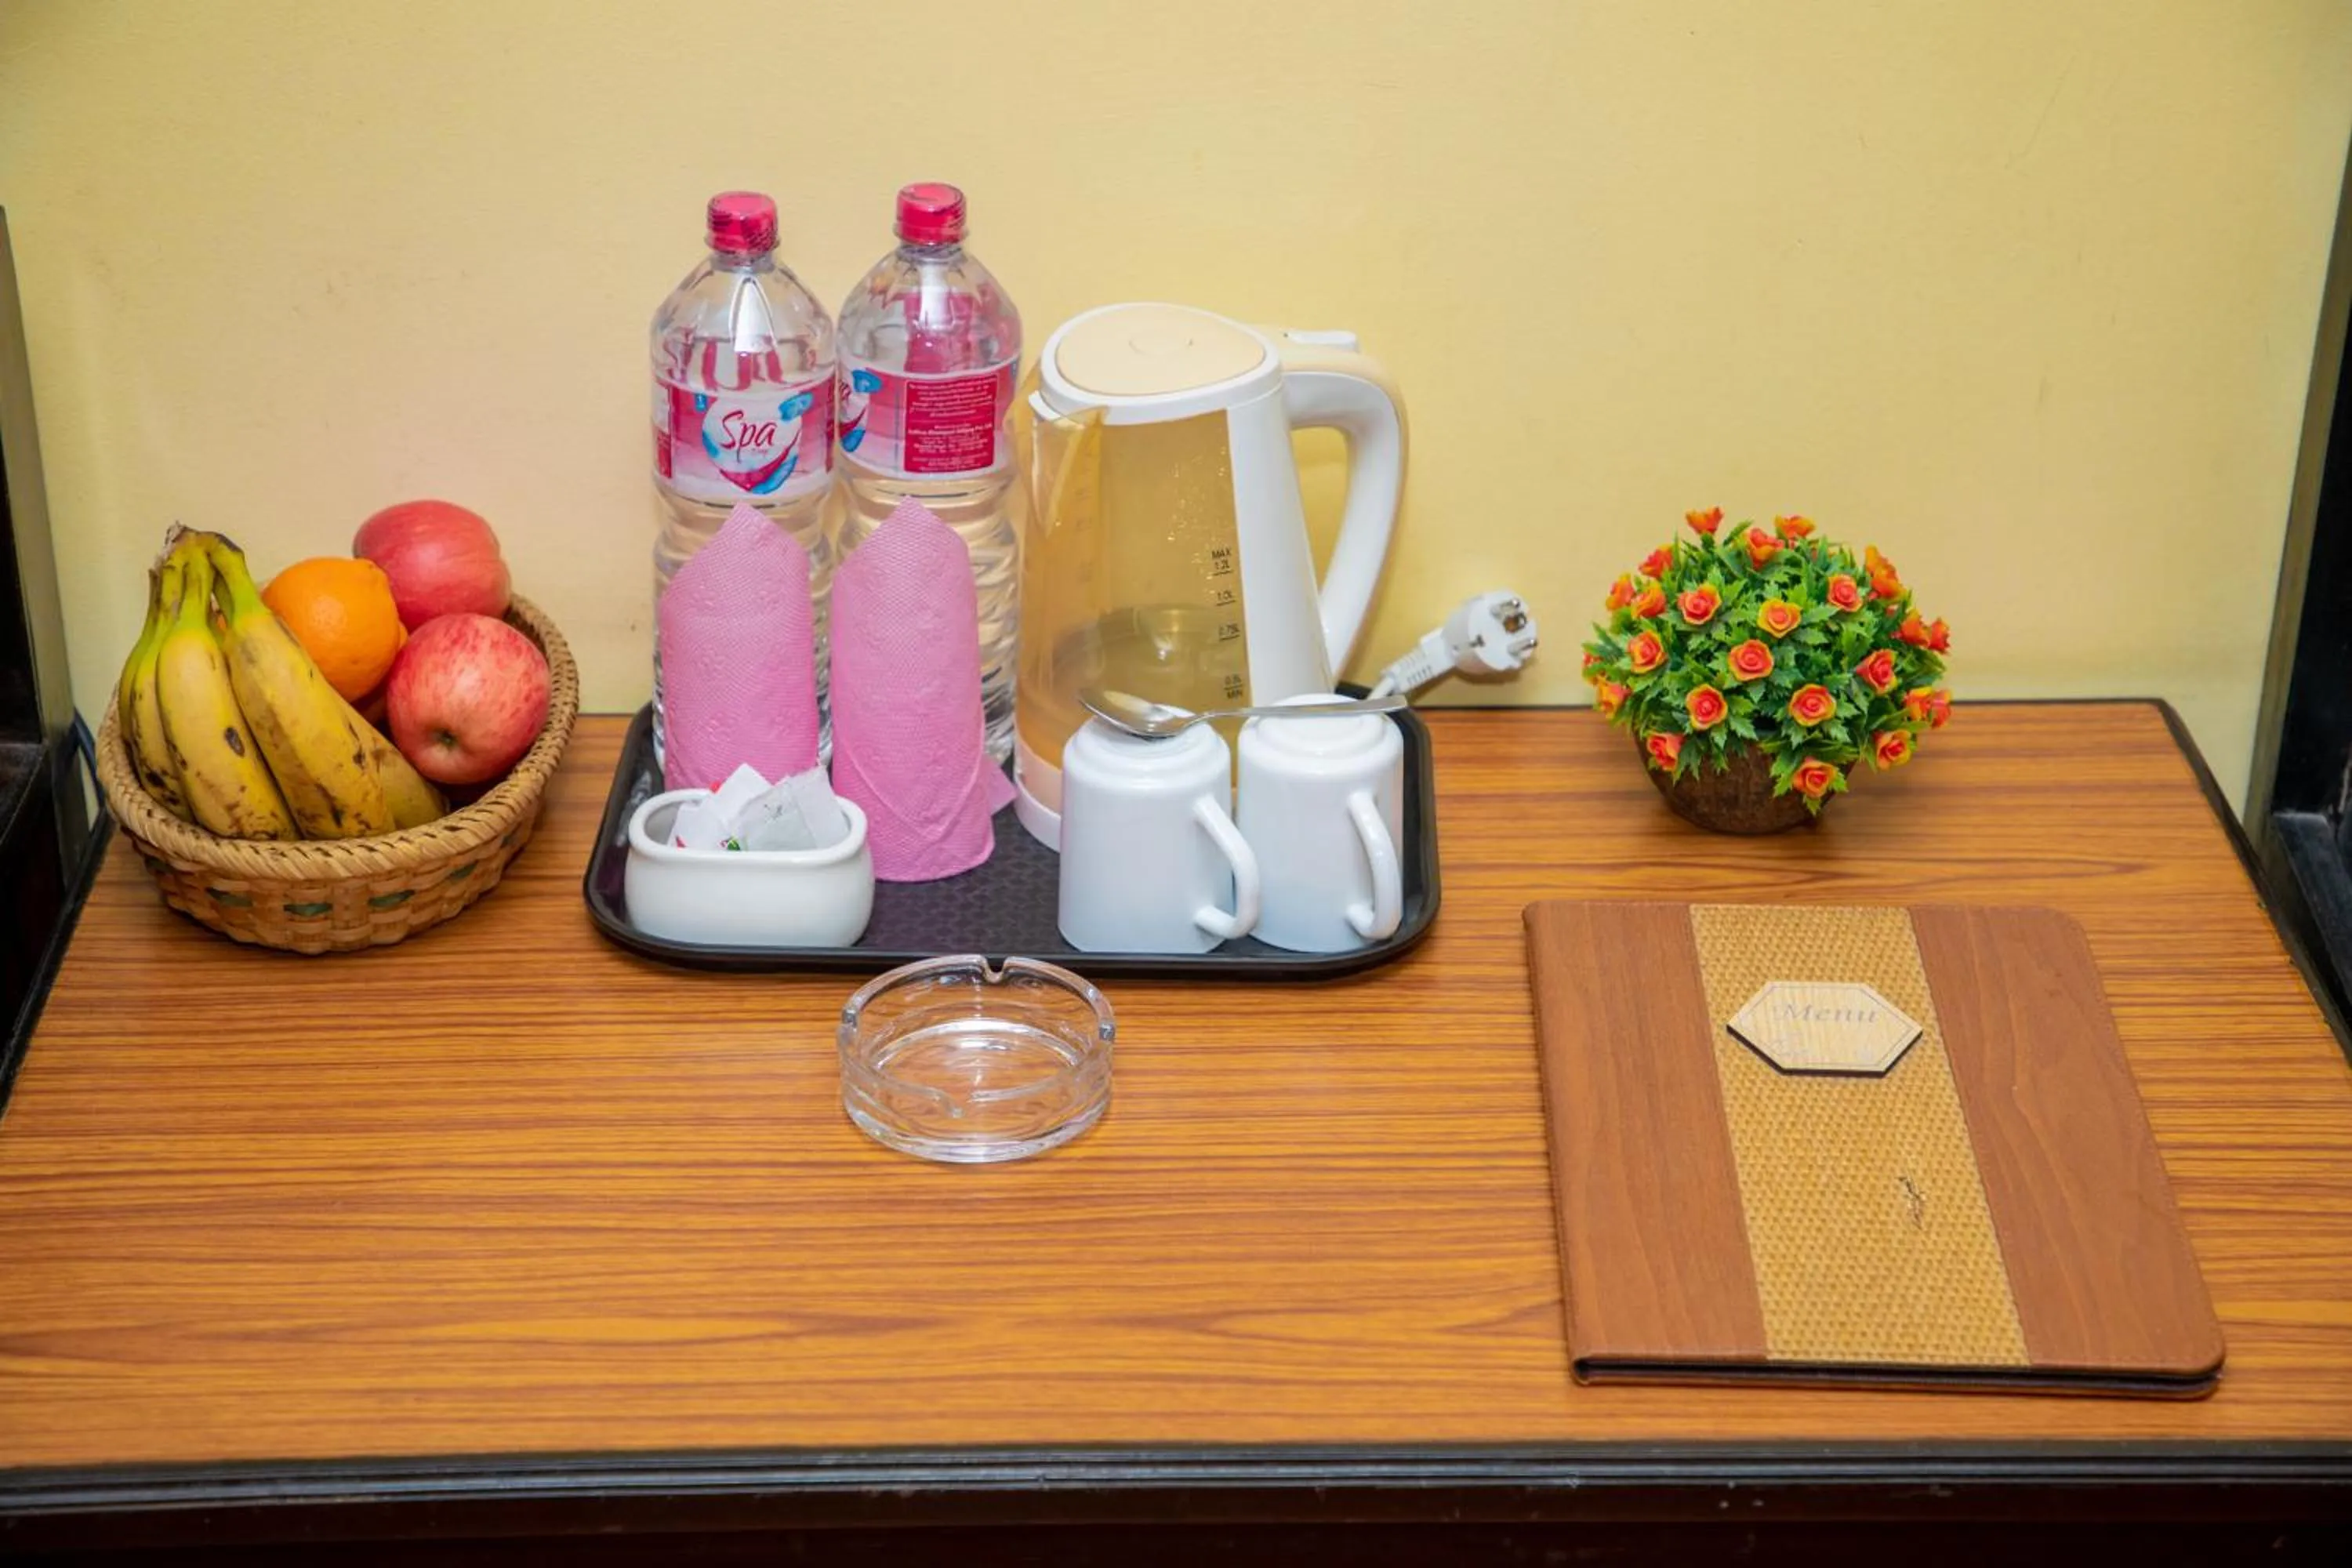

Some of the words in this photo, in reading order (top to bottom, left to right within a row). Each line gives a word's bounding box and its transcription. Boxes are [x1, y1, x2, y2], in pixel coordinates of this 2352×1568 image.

[720, 409, 777, 463] Spa
[1212, 547, 1232, 560] MAX
[1778, 1004, 1877, 1022] Menu
